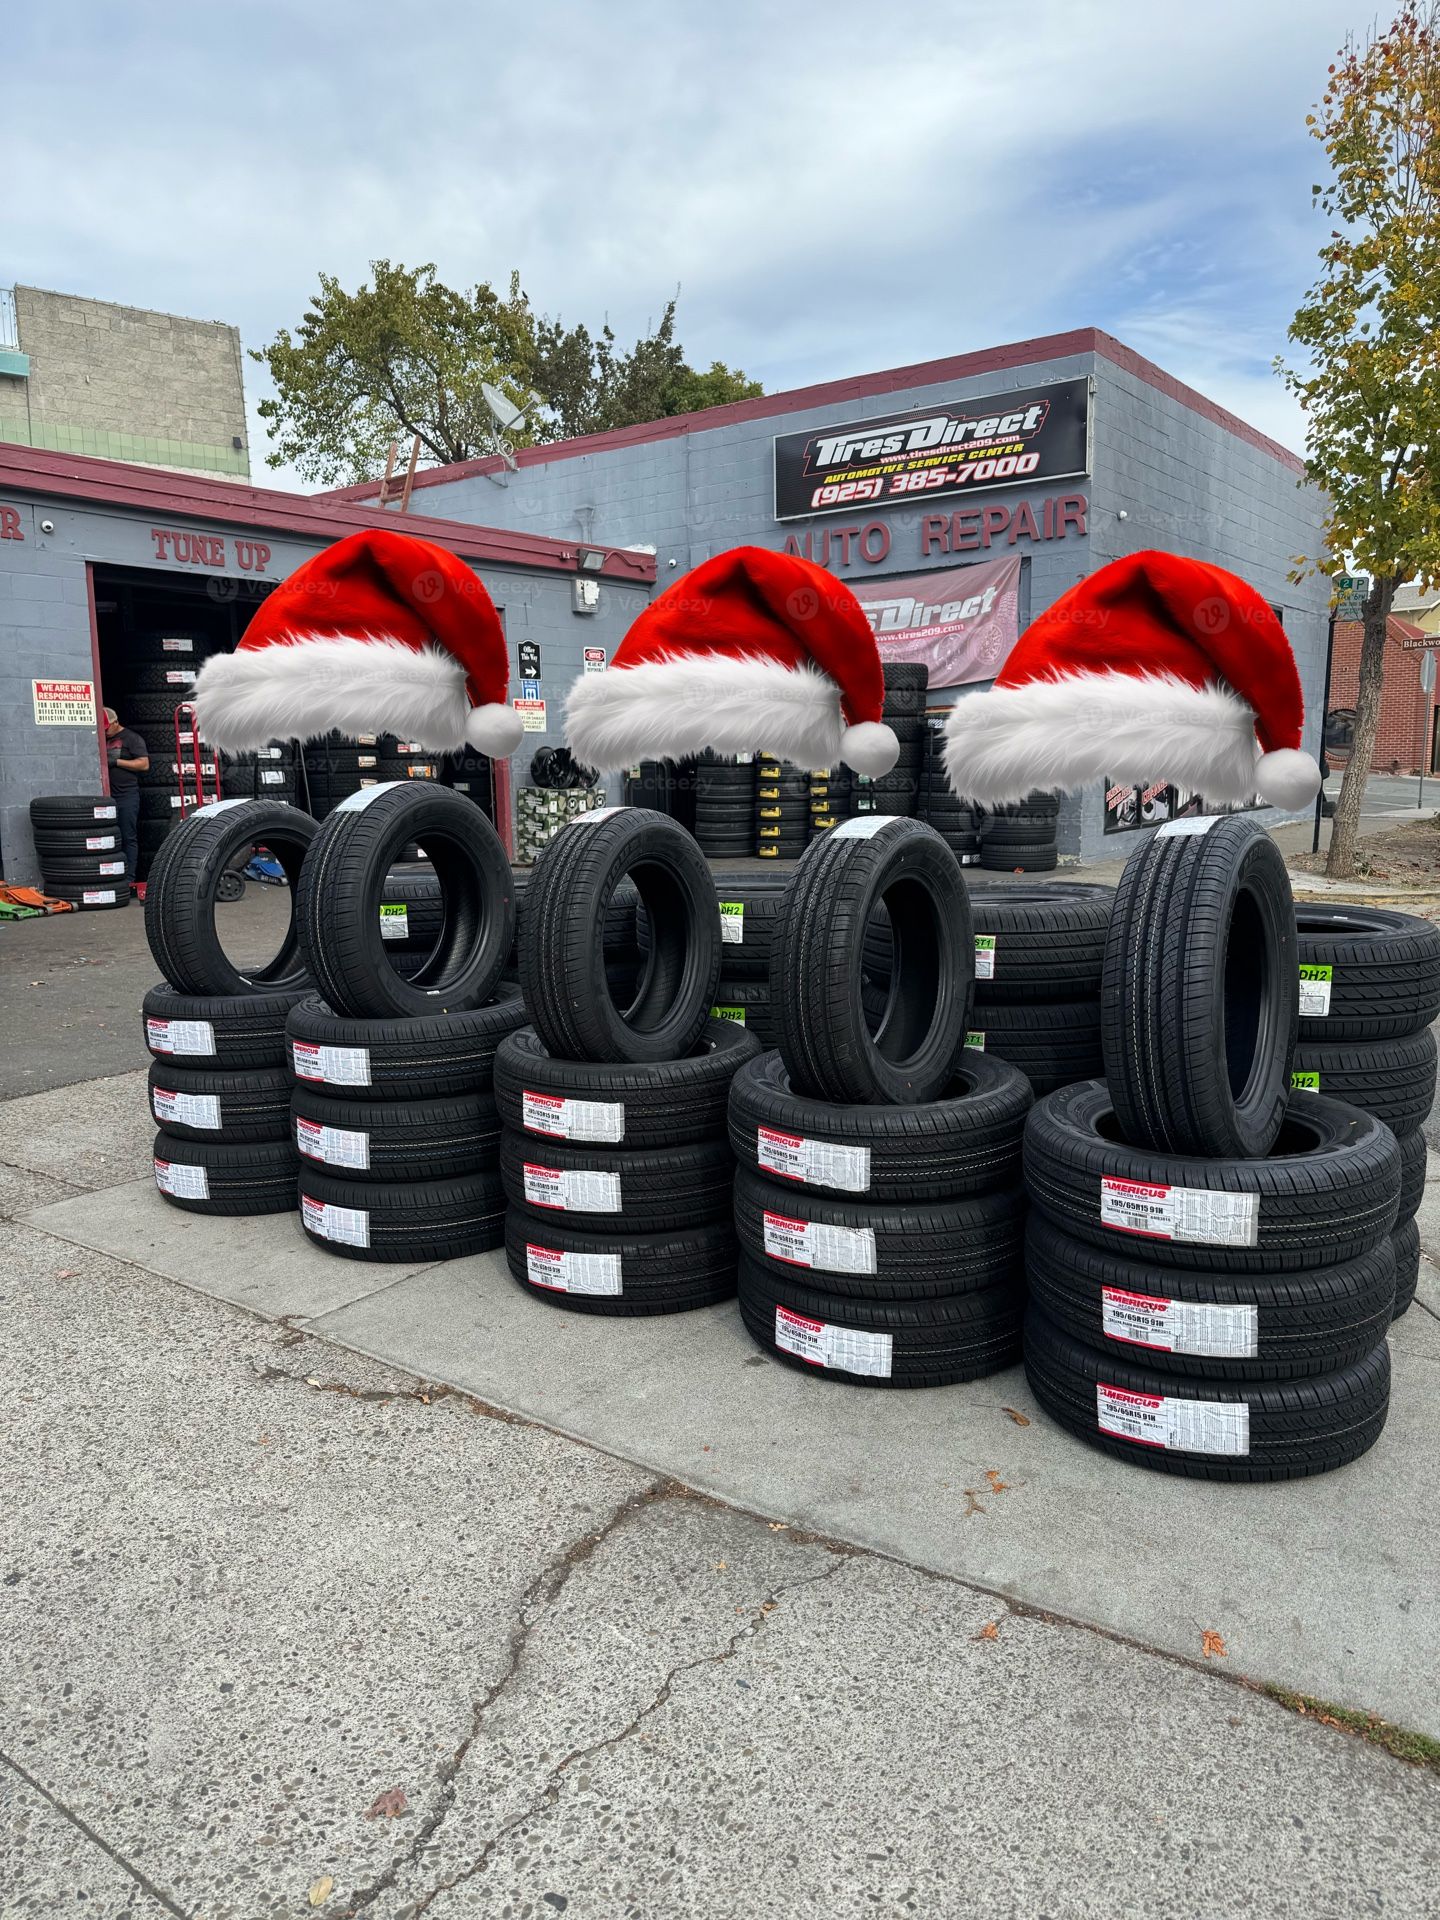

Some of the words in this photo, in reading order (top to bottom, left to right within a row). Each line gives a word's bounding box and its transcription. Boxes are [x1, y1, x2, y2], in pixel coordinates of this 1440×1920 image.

[880, 435, 1021, 464] www.tiresdirect209.com
[824, 463, 905, 484] AUTOMOTIVE
[907, 453, 966, 471] SERVICE
[968, 443, 1025, 460] CENTER
[811, 477, 884, 508] (925)
[889, 452, 1041, 493] 385-7000
[922, 494, 1088, 557] REPAIR
[151, 528, 225, 567] TUNE
[234, 540, 272, 572] UP
[1357, 579, 1365, 590] P
[876, 623, 964, 642] www.tires209.com
[523, 645, 535, 654] Office
[530, 654, 538, 662] Way
[38, 692, 91, 700] RESPONSIBLE
[41, 684, 54, 692] WE
[54, 684, 70, 692] ARE
[70, 685, 86, 693] NOT
[385, 907, 404, 916] DH2
[721, 1010, 742, 1020] DH2
[524, 1094, 563, 1109] AMERICUS
[760, 1130, 800, 1149] AMERICUS
[525, 1168, 560, 1179] AMERICUS
[1103, 1181, 1166, 1198] AMERICUS
[1111, 1199, 1148, 1212] 195/65R15
[1150, 1206, 1163, 1214] 91H
[765, 1216, 805, 1233] AMERICUS
[527, 1248, 561, 1261] AMERICUS
[1104, 1292, 1167, 1312] AMERICUS
[778, 1311, 821, 1333] AMERICUS
[1112, 1310, 1149, 1324] 195/65R15
[1150, 1318, 1164, 1327] 91H
[808, 1335, 818, 1344] 91H
[1099, 1388, 1160, 1408] AMERICUS
[1106, 1403, 1142, 1418] 195/65R15
[1143, 1413, 1156, 1421] 91H
